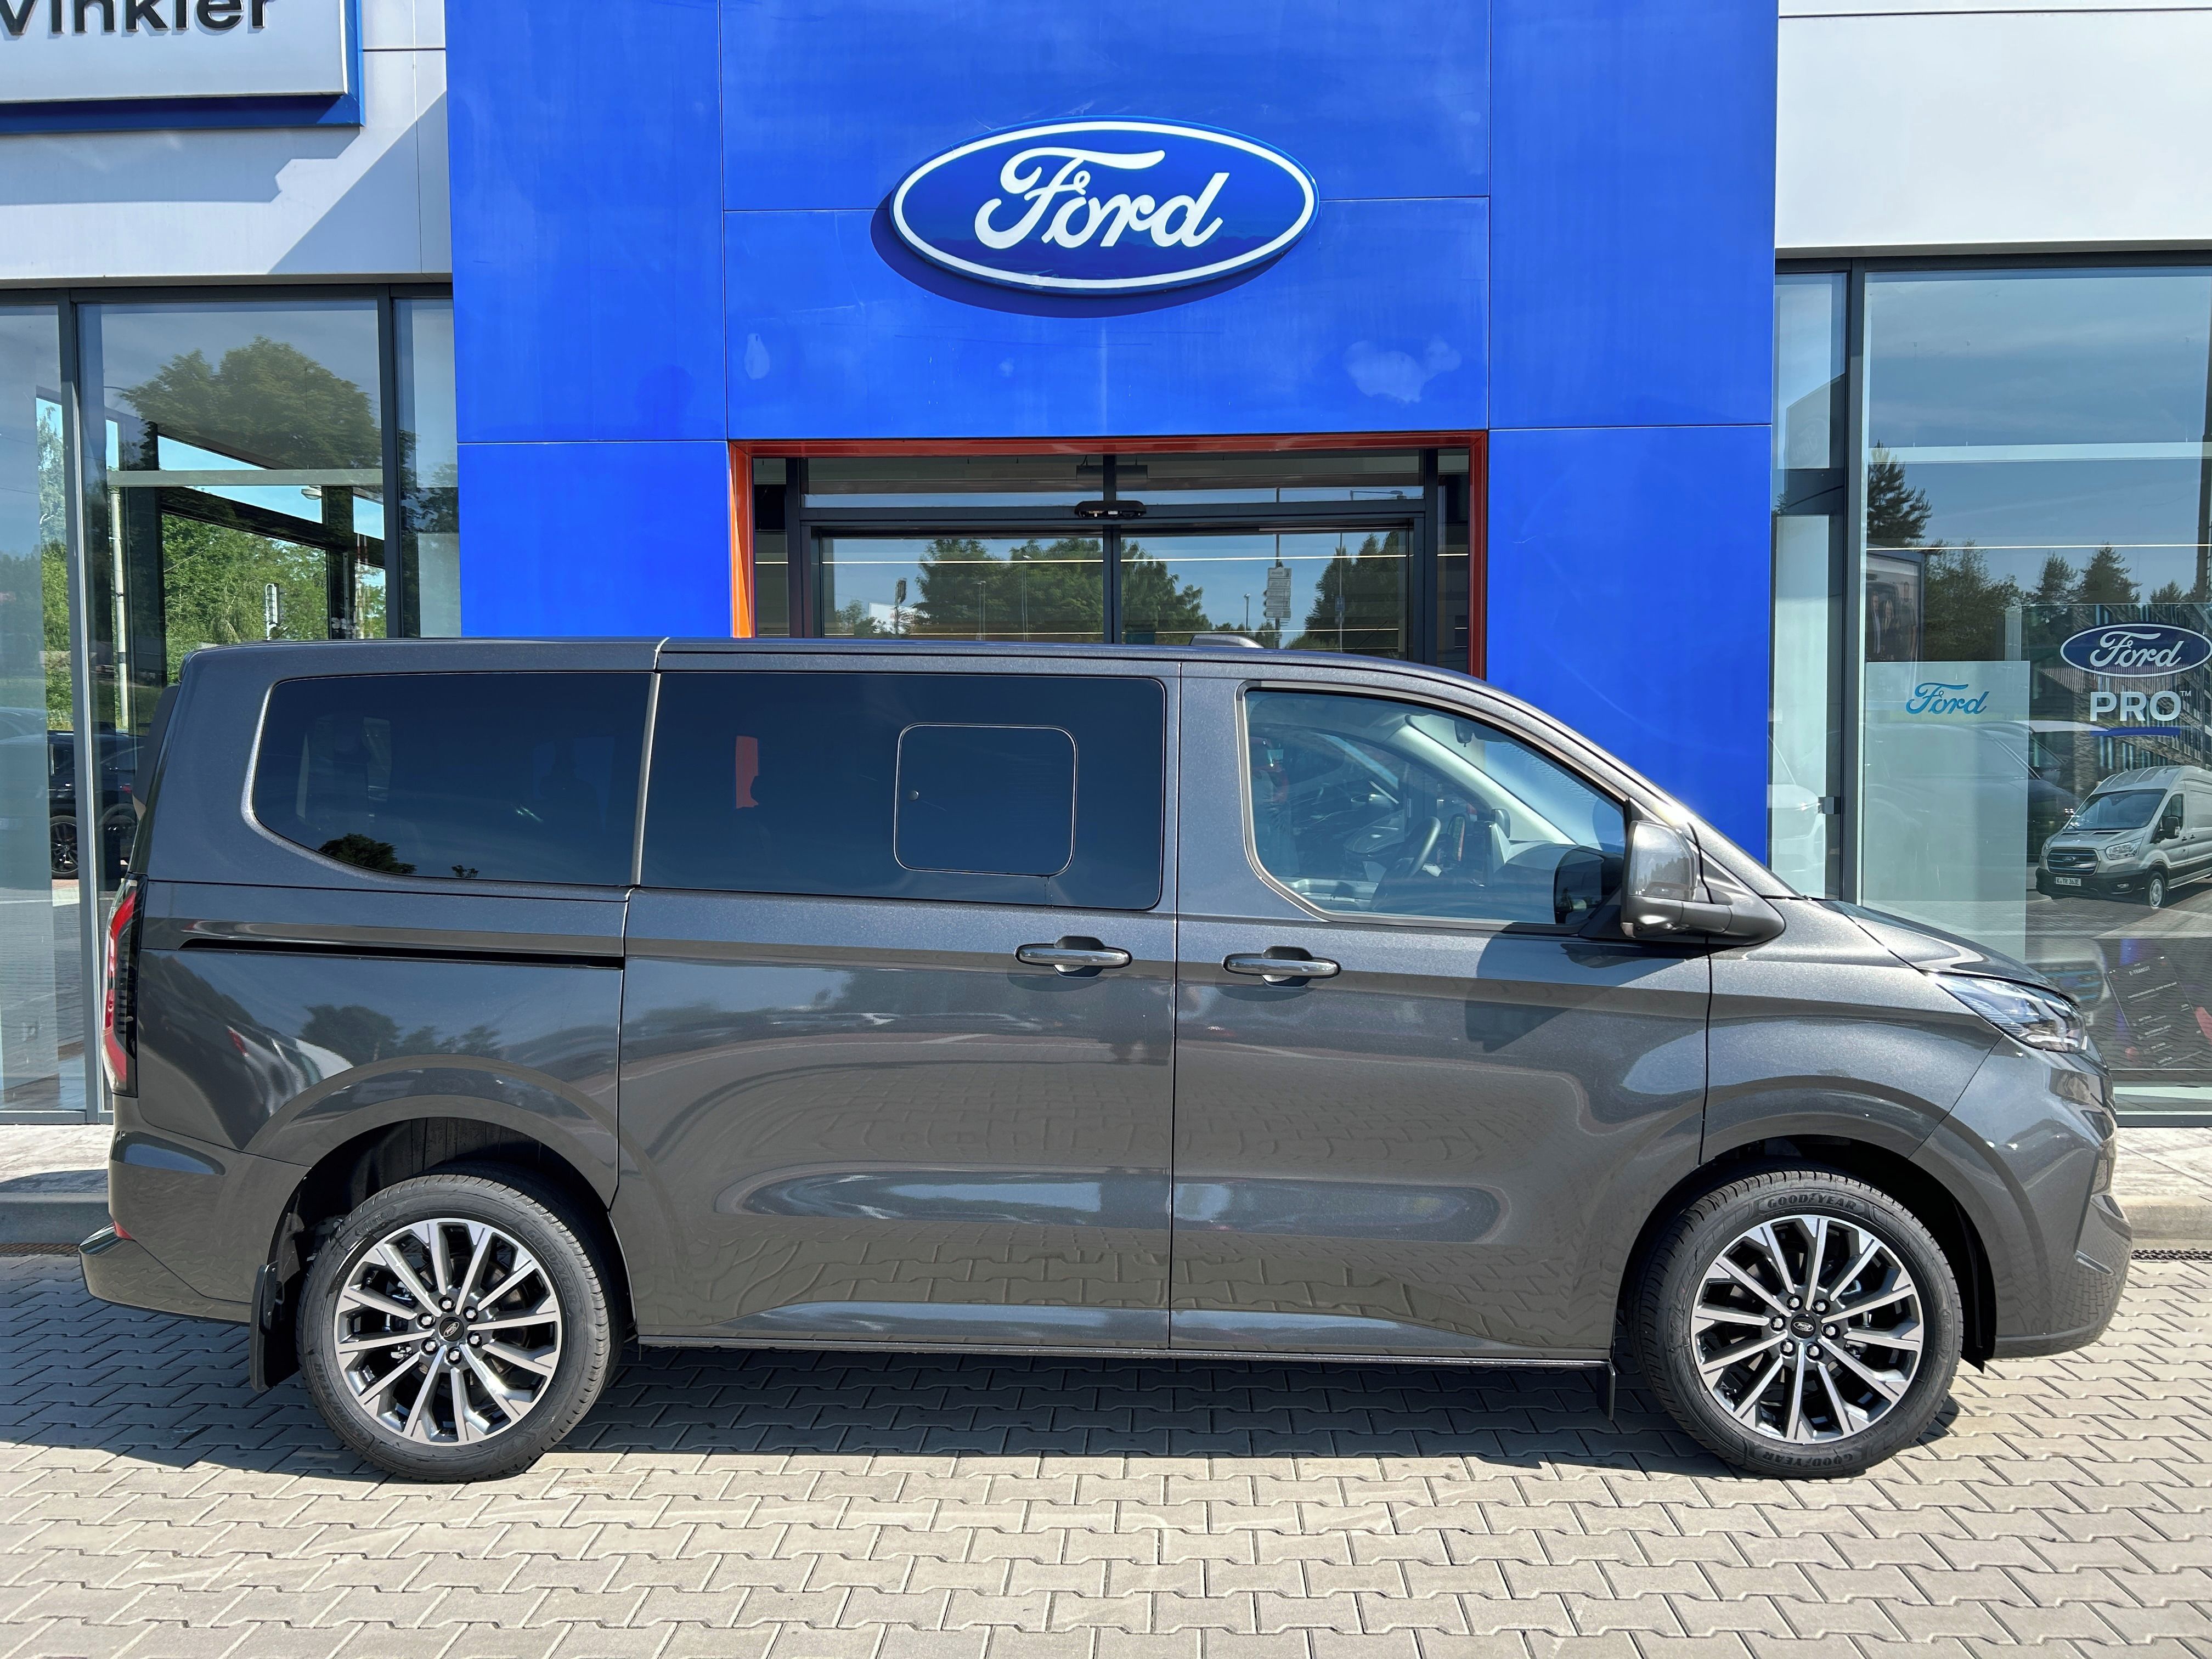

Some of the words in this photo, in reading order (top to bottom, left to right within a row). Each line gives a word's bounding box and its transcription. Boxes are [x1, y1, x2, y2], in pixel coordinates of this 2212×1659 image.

[974, 147, 1229, 249] Ford
[2089, 631, 2185, 667] Ford
[1906, 682, 1990, 714] Ford
